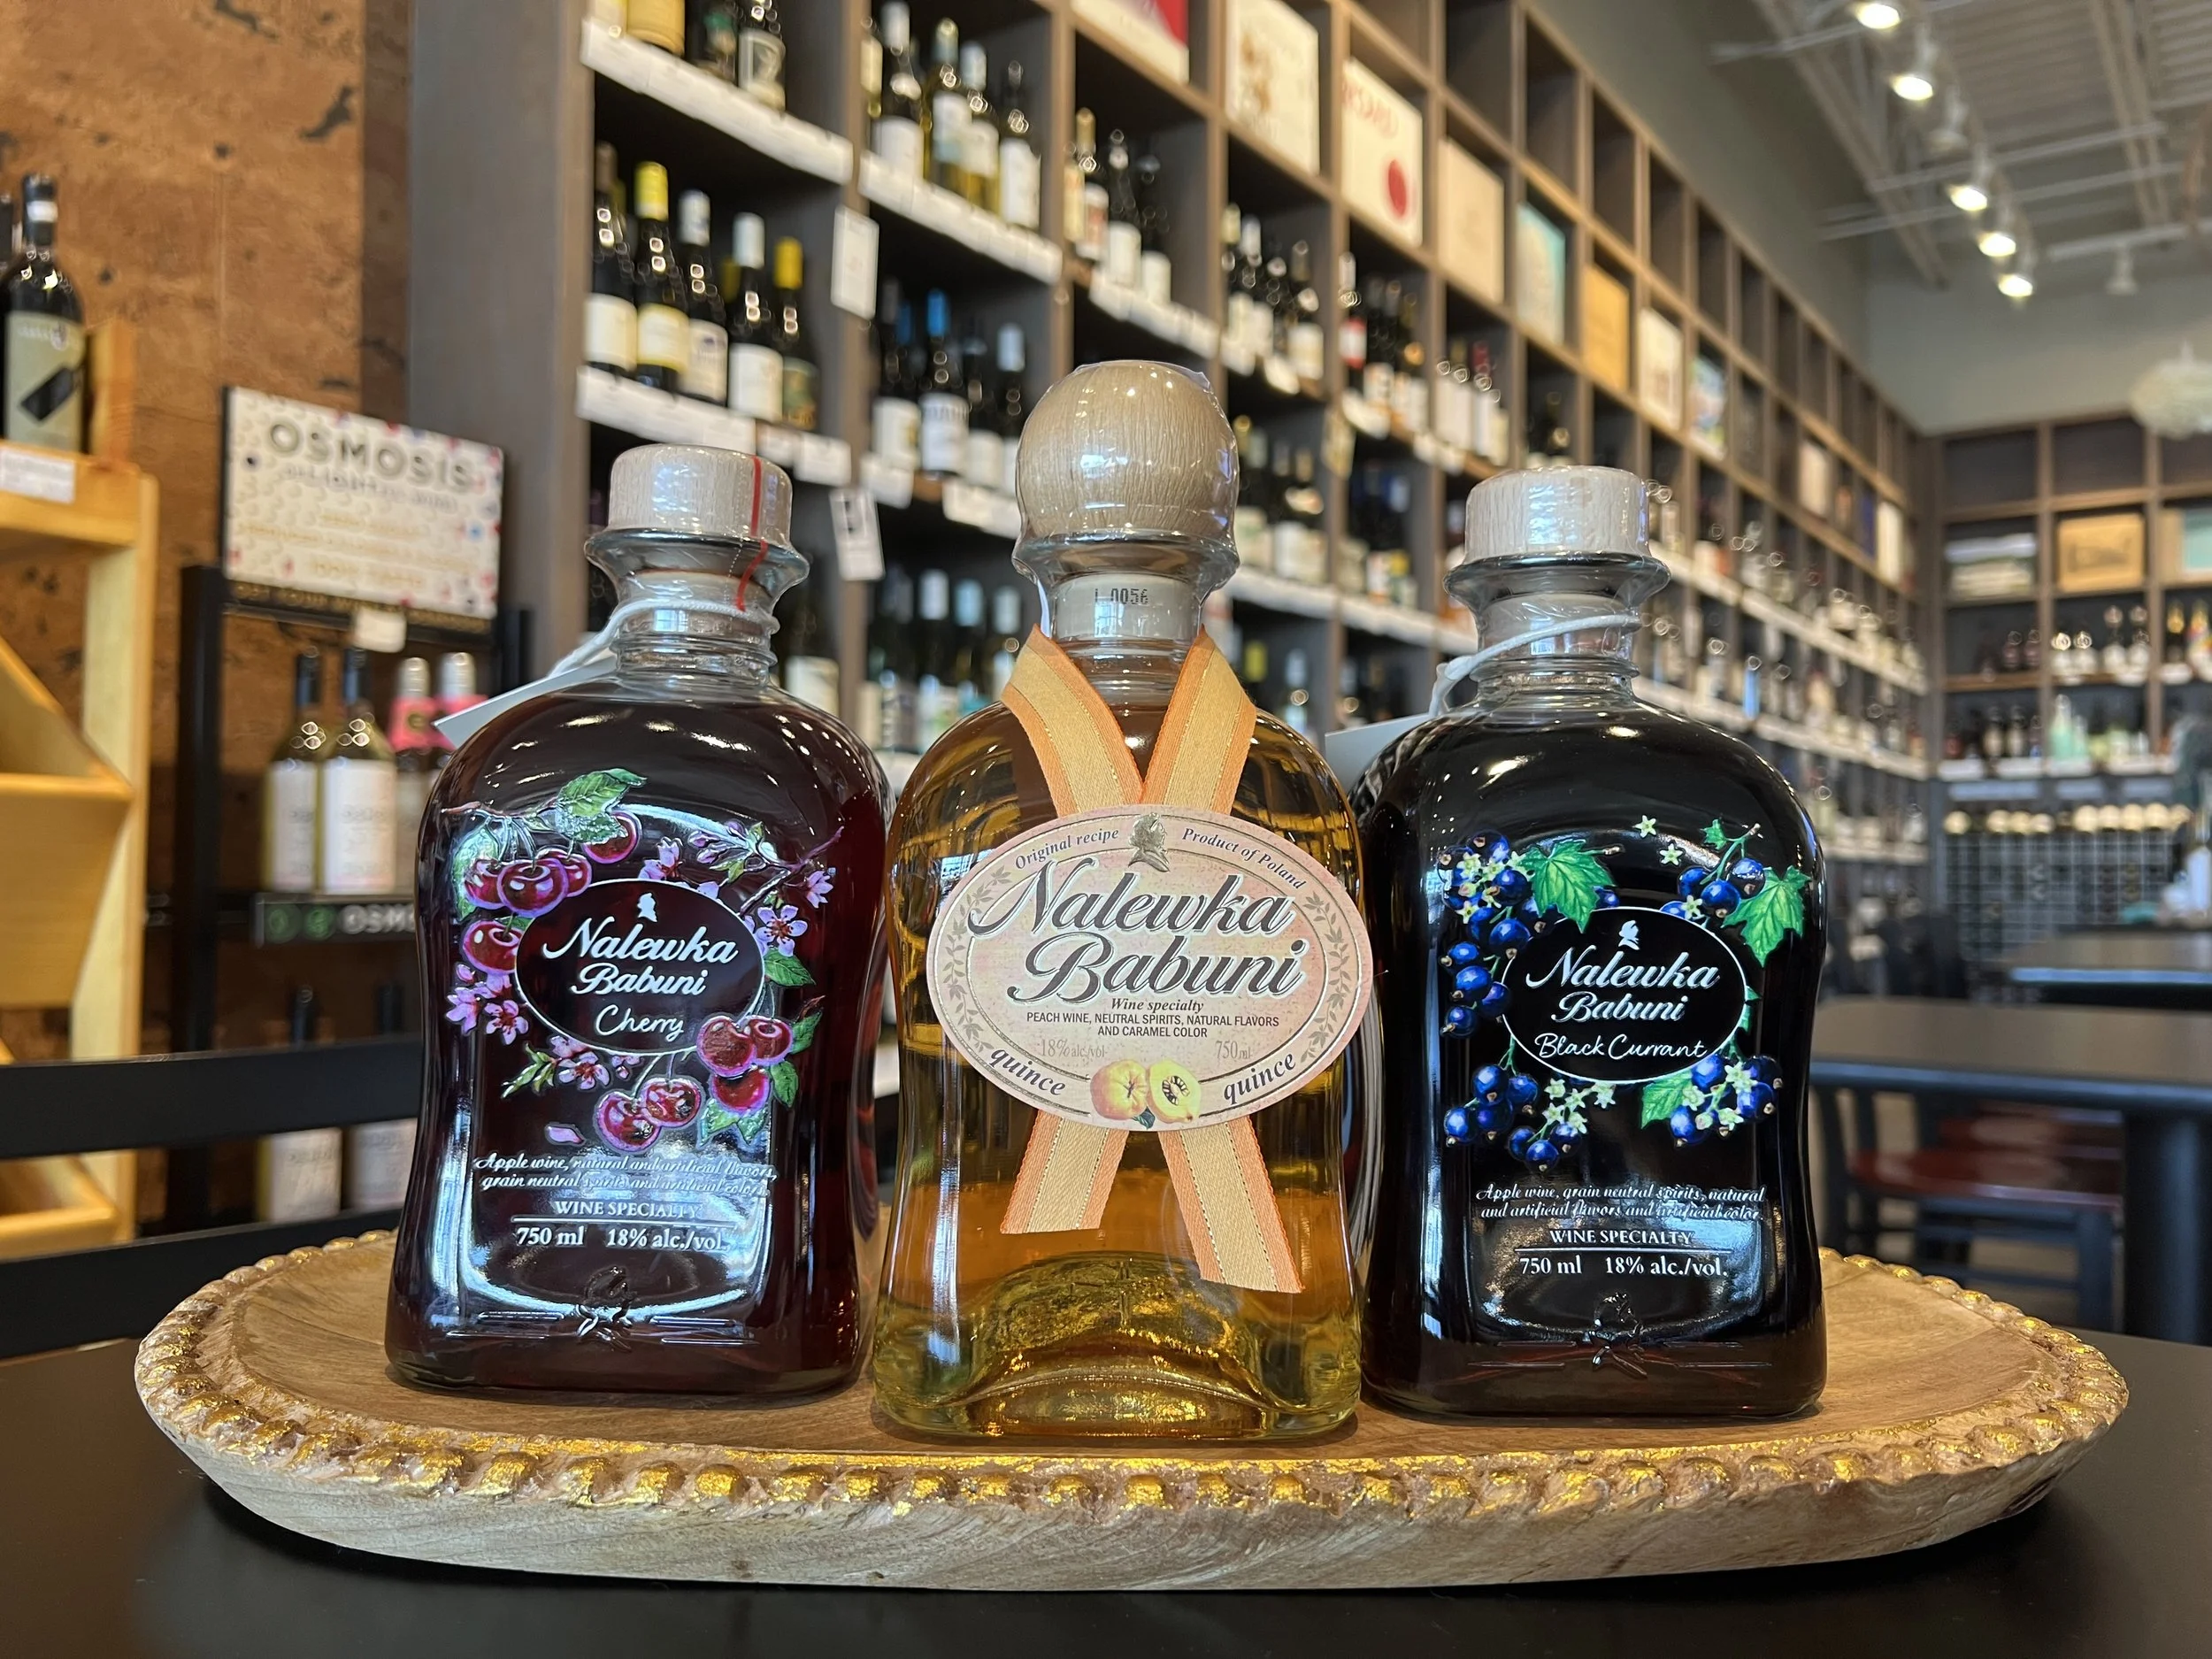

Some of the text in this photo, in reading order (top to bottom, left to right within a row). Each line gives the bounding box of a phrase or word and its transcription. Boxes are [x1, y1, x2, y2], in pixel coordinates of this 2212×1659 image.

[270, 419, 475, 493] OSMOSIS
[1016, 828, 1119, 869] Original recipe
[1182, 828, 1307, 889] Product of Poland
[968, 856, 1295, 934] Nalewka
[542, 916, 738, 964] Nalewka
[570, 962, 708, 995] Babuni
[1006, 932, 1309, 1003] Babuni
[1525, 944, 1720, 989] Nalewka
[1026, 1012, 1279, 1026] PEACH WINE, NEUTRAL SPIRITS, NATURAL FLAVORS
[1111, 998, 1204, 1014] Wine specialty
[1551, 991, 1688, 1023] Babuni
[595, 1004, 684, 1041] Cherry
[1097, 1026, 1208, 1037] AND CARAMEL COLOR
[1534, 1033, 1708, 1060] Black Currant
[989, 1048, 1065, 1095] quince
[1224, 1053, 1296, 1105] quince
[473, 1153, 529, 1171] Apple
[531, 1156, 569, 1171] wine,
[572, 1156, 628, 1170] natural
[630, 1156, 659, 1171] and
[661, 1156, 721, 1174] artificial
[481, 1174, 525, 1191] grain
[526, 1172, 581, 1187] neutral
[631, 1175, 661, 1189] and
[662, 1177, 723, 1193] artificial
[1476, 1184, 1765, 1202] Apple wine, grain neutral spirits, natural
[554, 1201, 699, 1218] WINE SPECIALTY
[1481, 1200, 1763, 1220] and artificial flavors and artificial color.
[516, 1225, 730, 1250] 750 ml 18% alc./vol.
[1550, 1230, 1691, 1245] WINE SPECIALTY
[1520, 1255, 1728, 1277] 750 ml 18% alc./vol.
